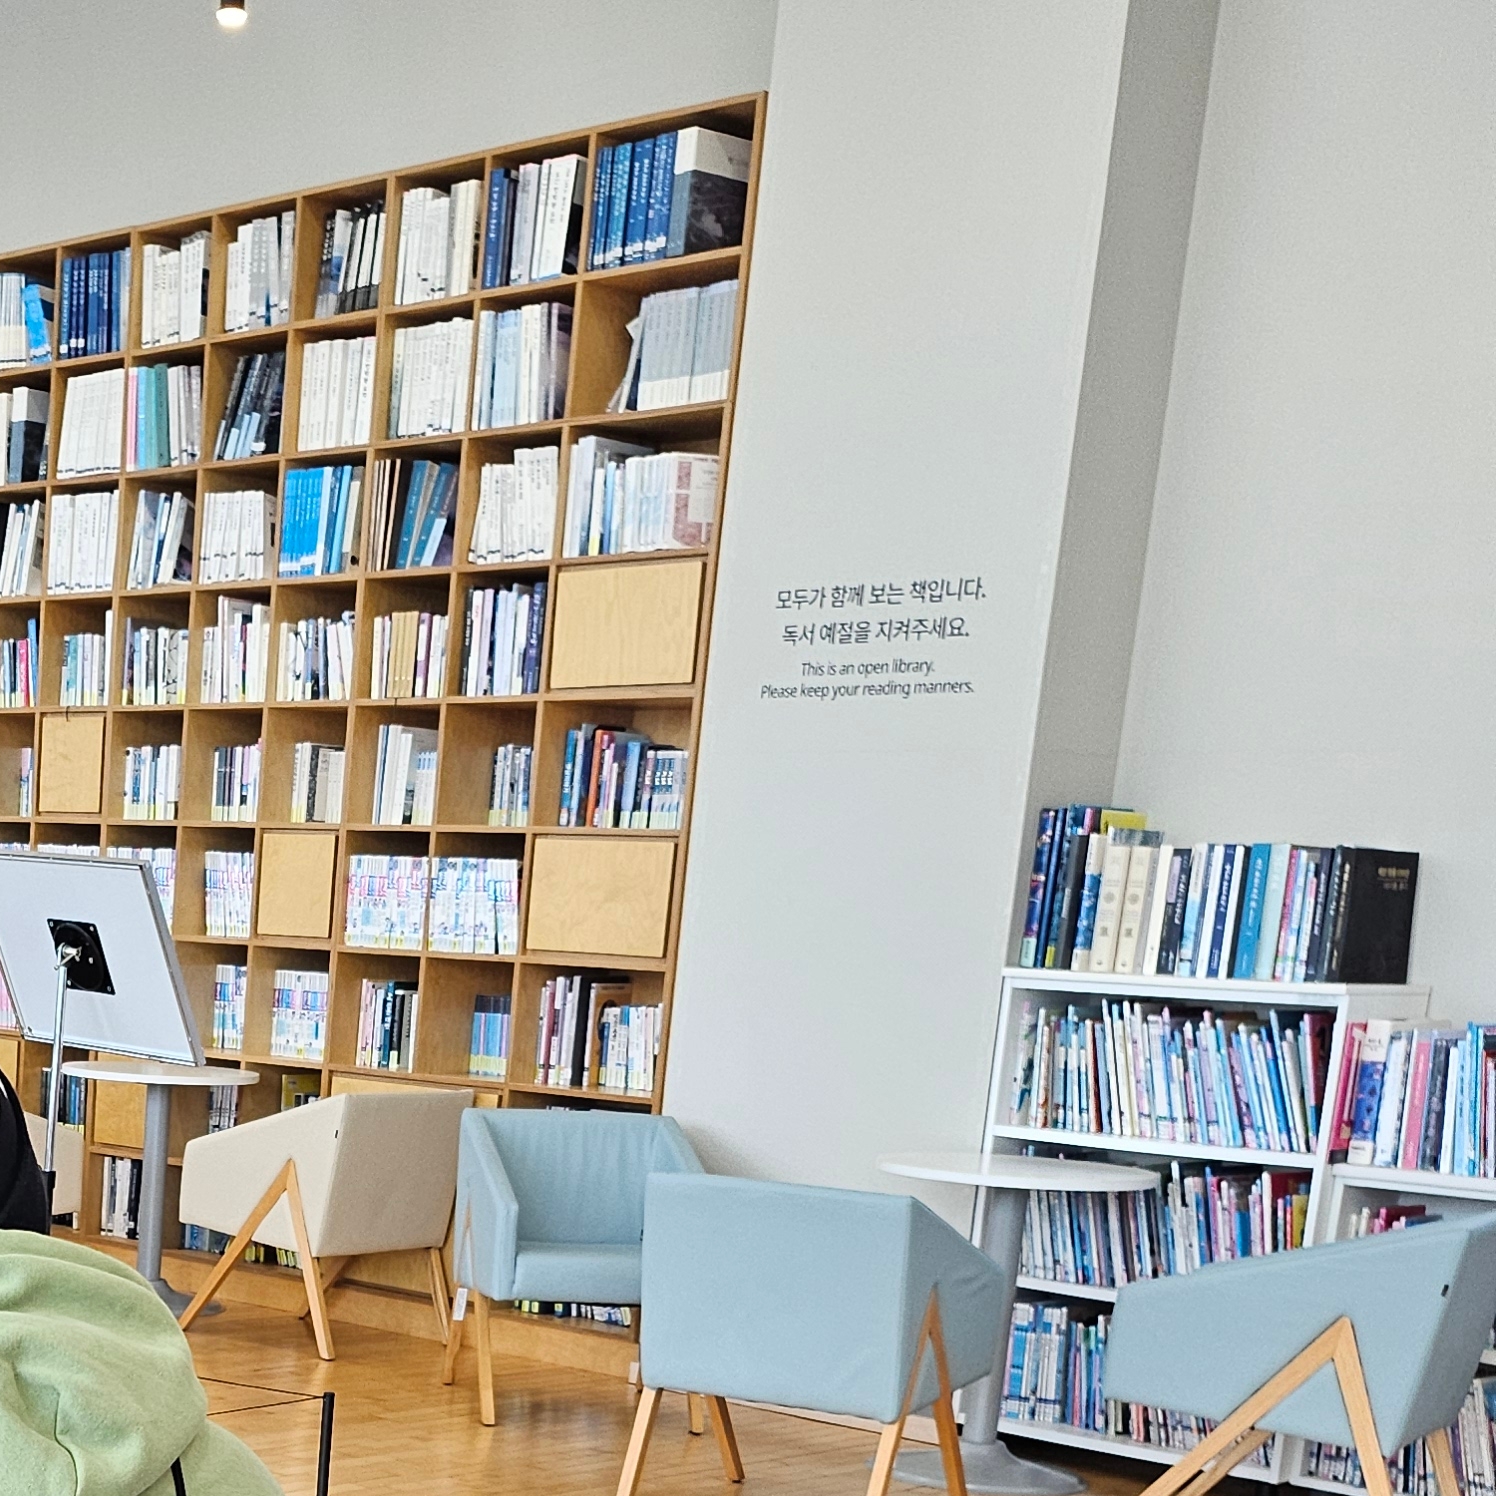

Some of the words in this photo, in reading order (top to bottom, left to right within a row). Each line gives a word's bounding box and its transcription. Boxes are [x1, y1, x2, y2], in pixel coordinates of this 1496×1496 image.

[775, 586, 826, 610] 모두가
[830, 583, 865, 608] 함께
[868, 582, 905, 606] 보는
[909, 576, 987, 603] 책입니다.
[781, 622, 816, 647] 독서
[819, 620, 872, 645] 예절을
[875, 615, 971, 642] 지켜주세요.
[801, 661, 825, 677] This
[826, 661, 837, 676] is
[838, 663, 855, 676] an
[857, 661, 889, 679] open
[891, 658, 936, 677] library.
[760, 683, 798, 699] Please
[799, 683, 830, 701] keep
[830, 684, 861, 701] your
[861, 680, 911, 700] reading
